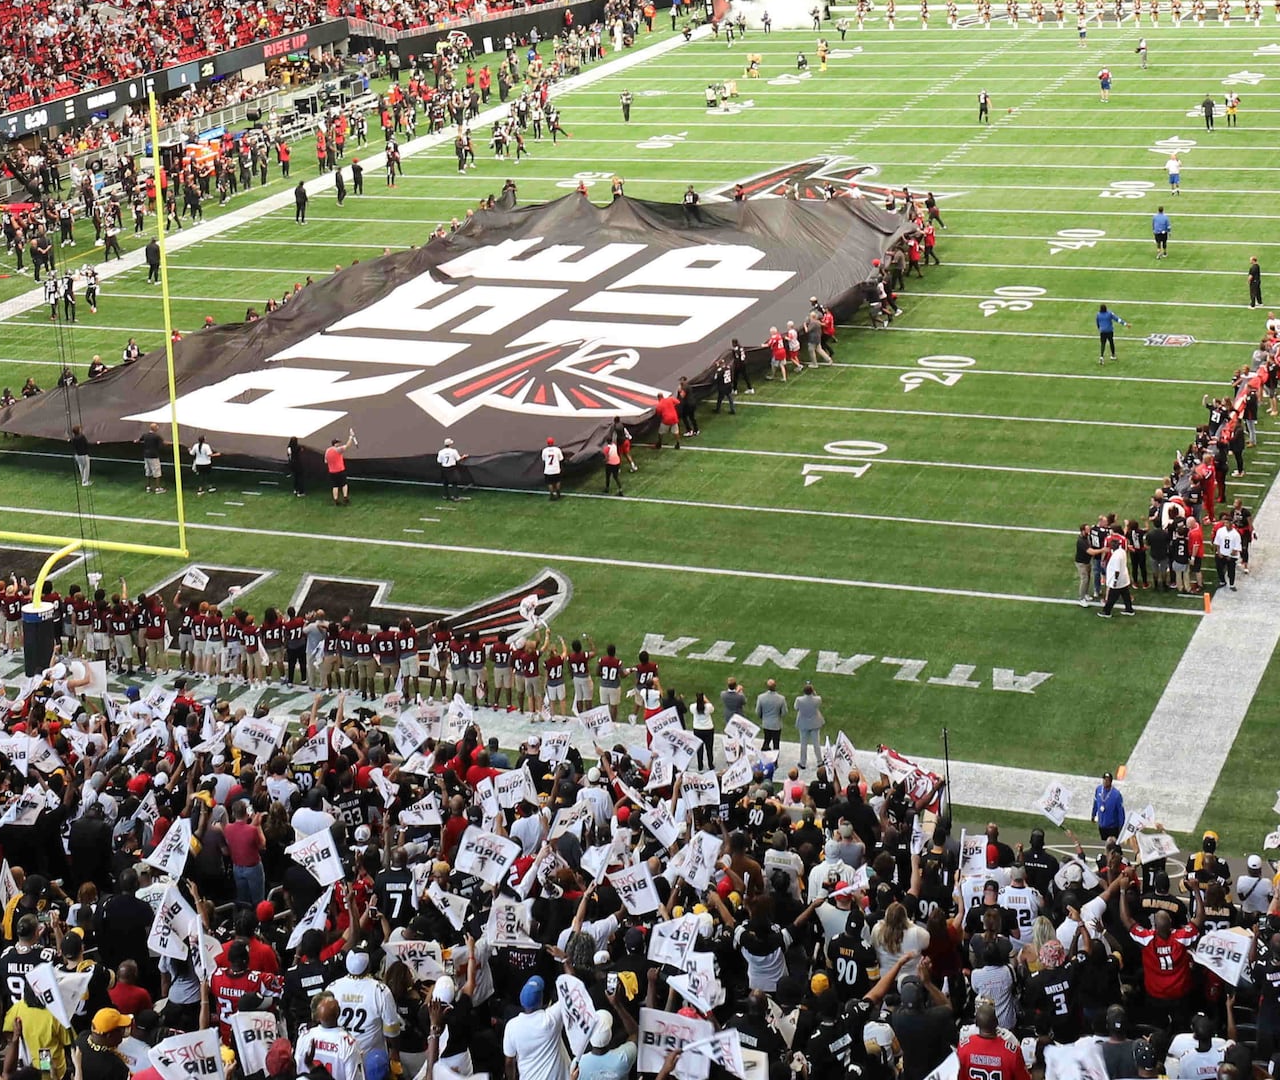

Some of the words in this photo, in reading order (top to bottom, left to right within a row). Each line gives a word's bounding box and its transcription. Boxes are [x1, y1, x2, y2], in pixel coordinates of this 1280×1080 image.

[264, 40, 288, 58] RISE
[290, 34, 308, 51] UP
[1048, 228, 1107, 255] 40
[504, 243, 795, 348] UP
[977, 286, 1046, 317] 30
[120, 236, 646, 439] RISE
[899, 355, 976, 393] 20
[801, 440, 889, 488] 10
[290, 622, 302, 633] 77
[379, 640, 393, 652] 63
[399, 637, 414, 650] 98
[468, 648, 482, 658] 45
[495, 653, 508, 663] 37
[550, 665, 562, 677] 40
[640, 633, 1053, 694] ATLANTA
[602, 667, 617, 679] 90
[295, 773, 313, 790] 39
[683, 781, 715, 792] BIRDS
[748, 809, 763, 825] 90
[389, 893, 403, 918] 7
[839, 947, 855, 956] WATT
[8, 963, 34, 974] MILLER
[836, 958, 858, 985] 90
[1160, 956, 1174, 971] 11
[1044, 983, 1062, 996] BATES
[1052, 994, 1069, 1016] 3
[342, 1007, 367, 1033] 22
